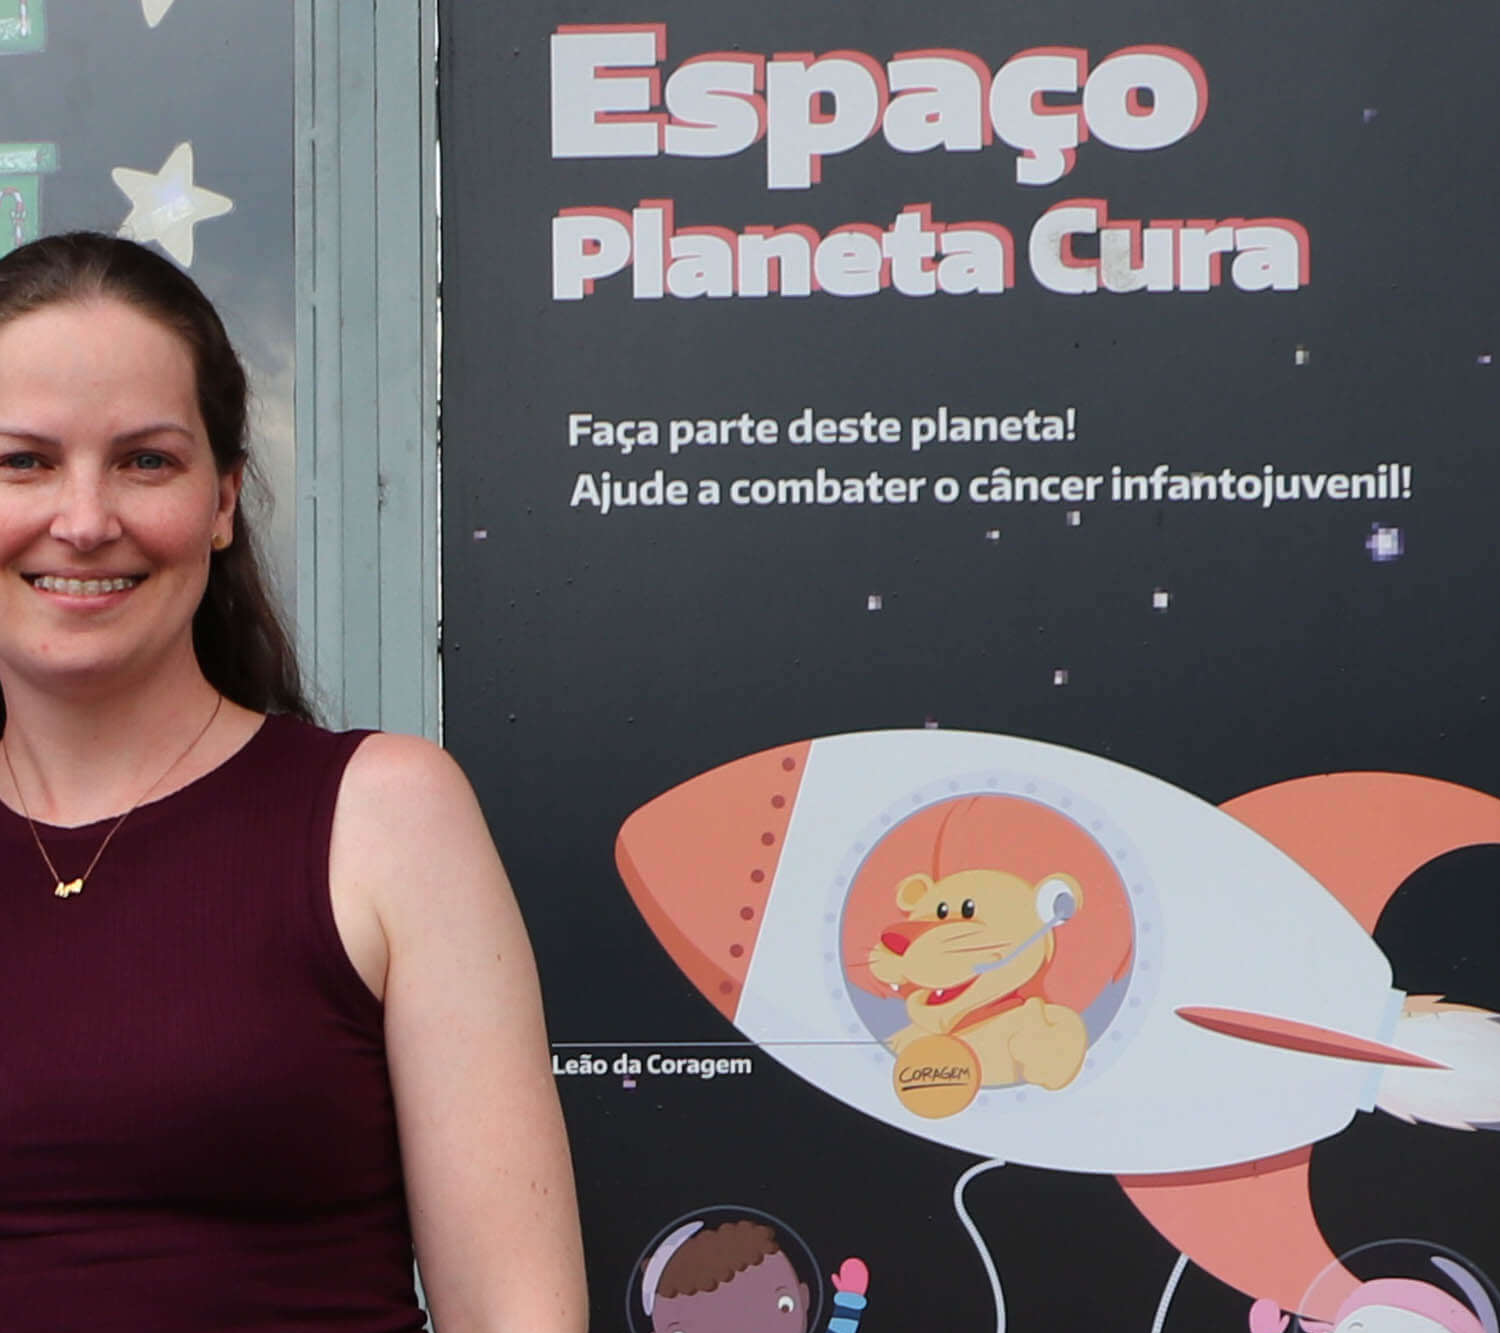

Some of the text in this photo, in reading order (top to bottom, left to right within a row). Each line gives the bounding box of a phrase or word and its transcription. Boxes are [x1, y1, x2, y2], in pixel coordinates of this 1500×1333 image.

[551, 24, 1208, 190] Espaço
[552, 199, 1309, 300] Planeta Cura
[569, 406, 1077, 455] Faça parte deste planeta!
[570, 464, 1413, 514] Ajude a combater o câncer infantojuvenil!
[552, 1054, 752, 1079] Leão da Coragem
[900, 1065, 970, 1084] CORAGEM
